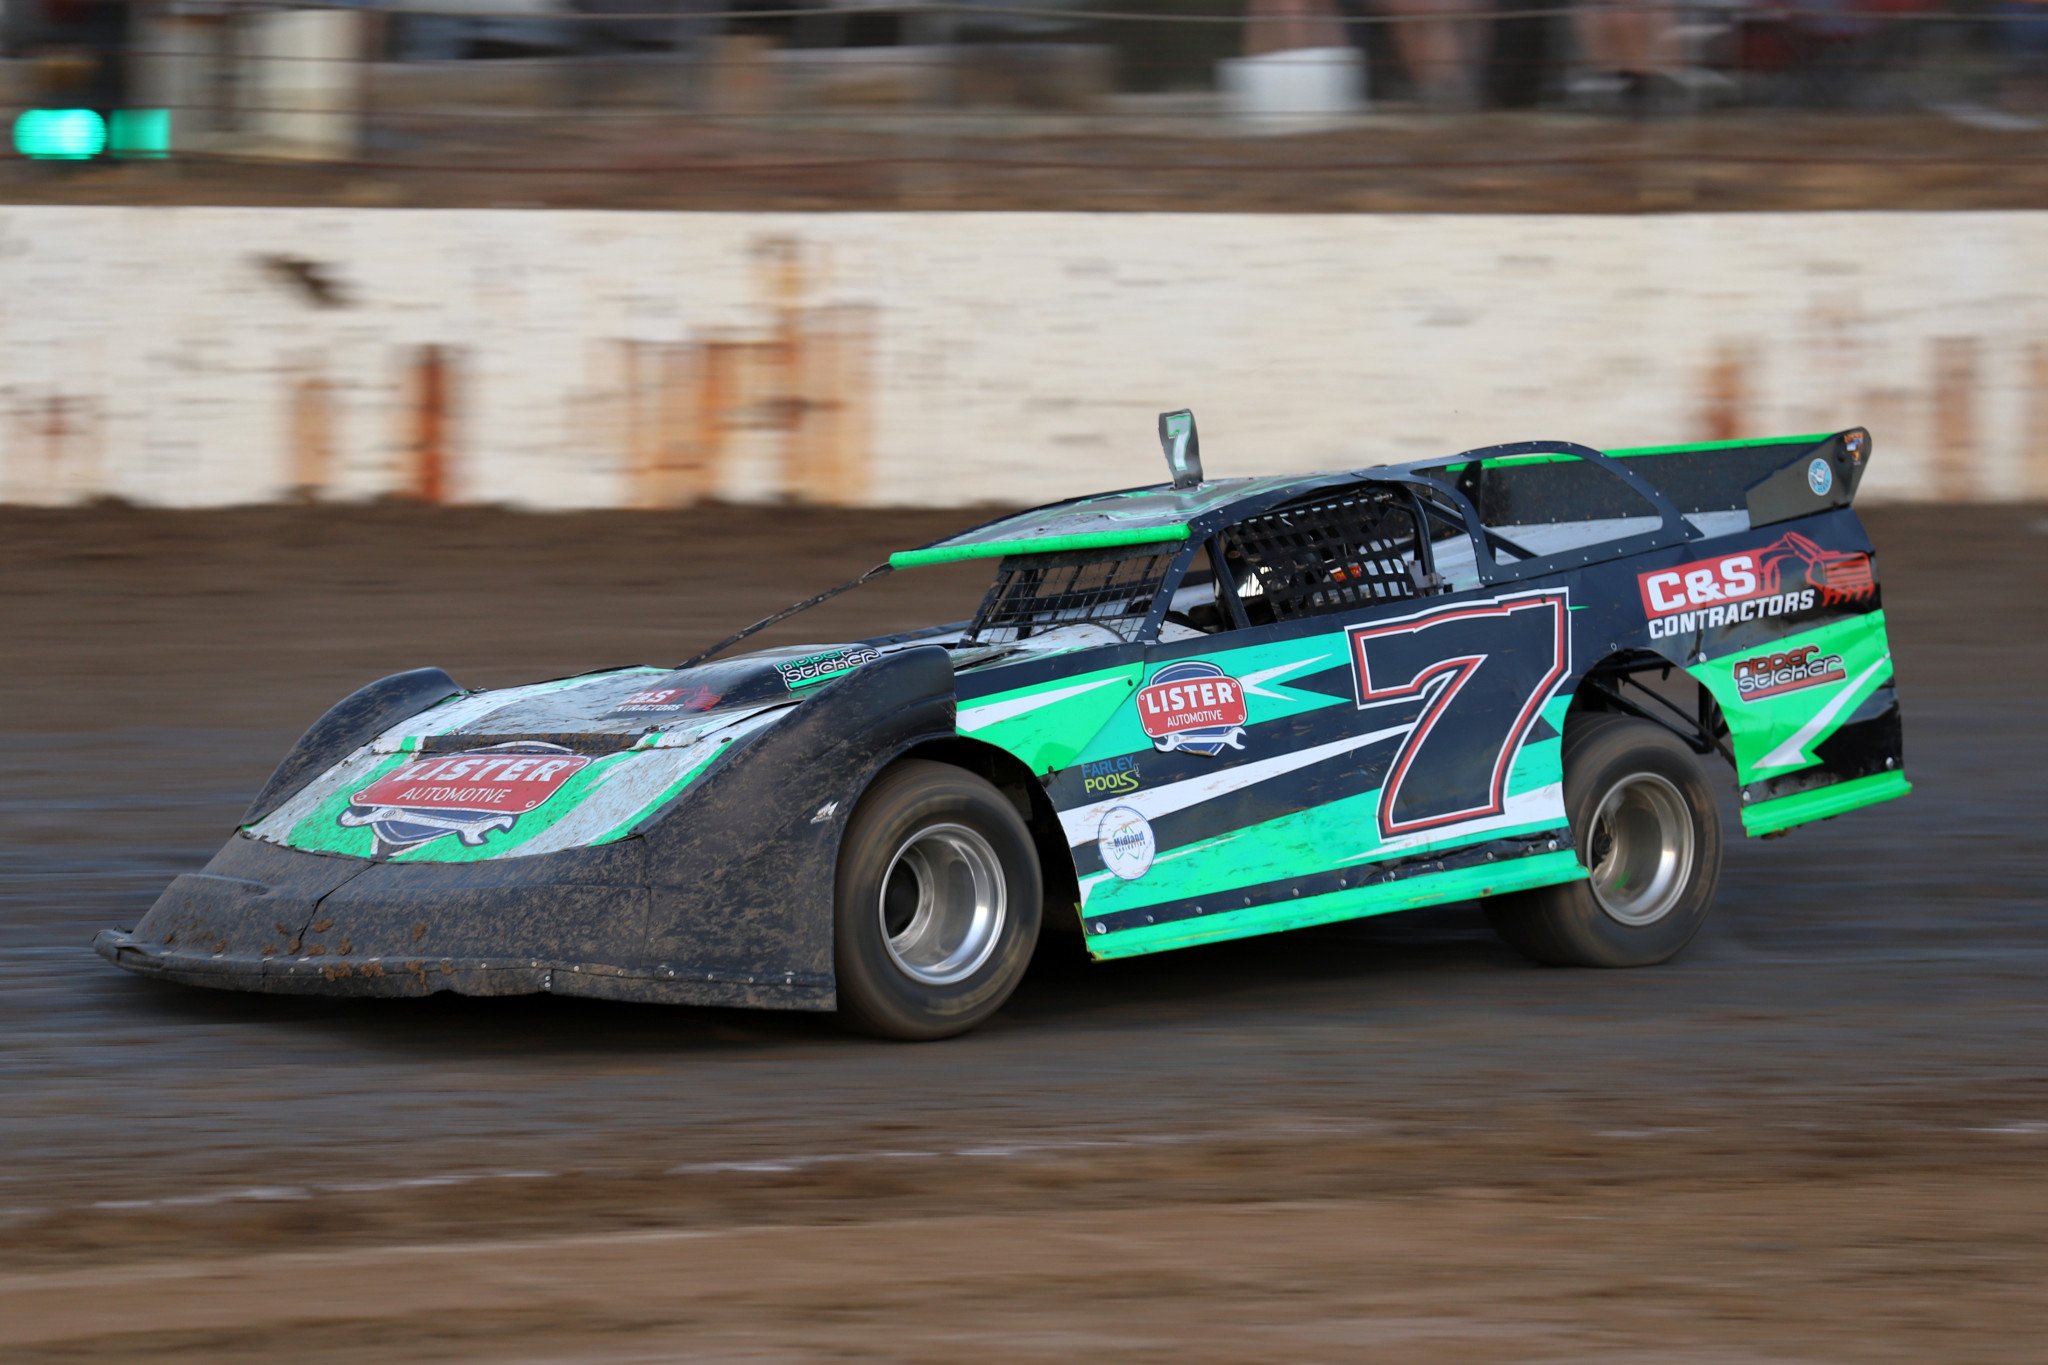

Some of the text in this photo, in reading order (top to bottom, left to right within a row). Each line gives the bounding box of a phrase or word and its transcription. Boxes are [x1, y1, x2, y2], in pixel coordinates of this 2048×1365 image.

[1166, 413, 1191, 471] 7
[1647, 556, 1757, 612] C&S
[1648, 589, 1815, 640] CONTRACTORS
[1146, 682, 1235, 714] LISTER
[1167, 710, 1223, 728] AUTOMOTIVE
[1344, 586, 1572, 844] 7
[393, 758, 570, 782] LISTER
[1082, 756, 1134, 778] FARLEY
[1084, 770, 1139, 793] POOLS
[397, 787, 513, 803] AUTOMOTIVE
[1113, 831, 1145, 847] Midland
